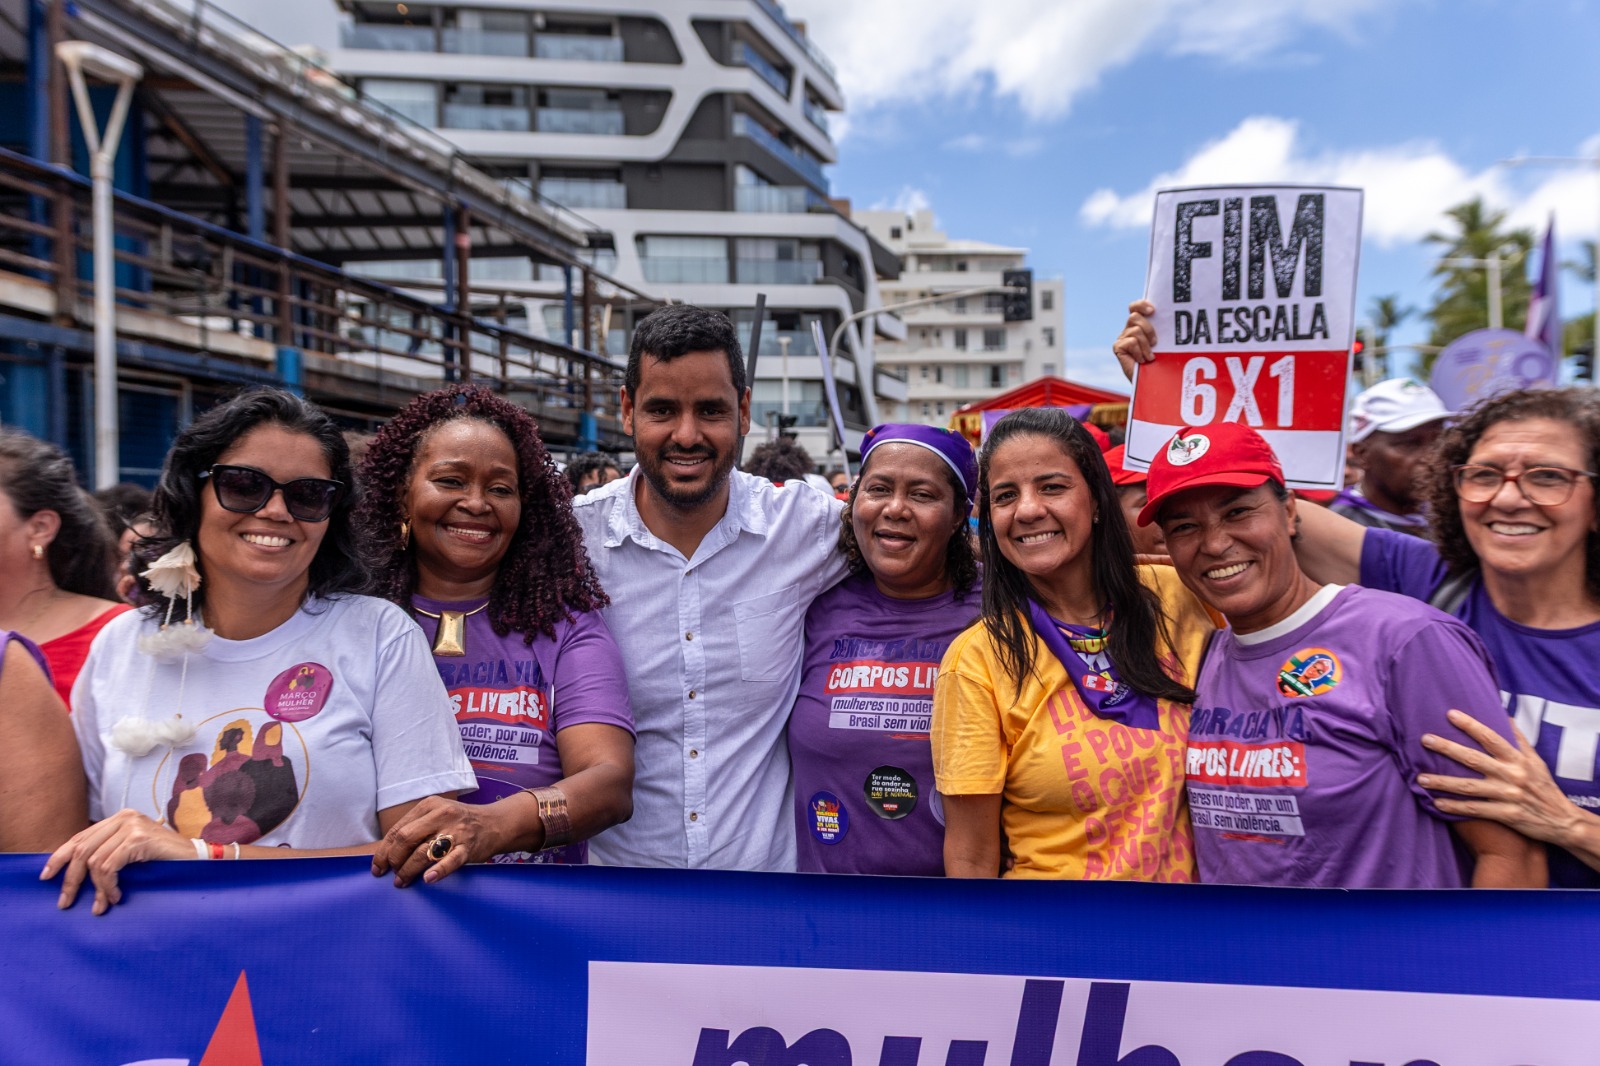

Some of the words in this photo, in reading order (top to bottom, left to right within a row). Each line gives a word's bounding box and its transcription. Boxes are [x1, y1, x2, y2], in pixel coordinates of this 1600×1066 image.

[1173, 193, 1325, 303] FIM
[1174, 309, 1212, 346] DA
[1217, 302, 1330, 344] ESCALA
[1180, 354, 1295, 427] 6X1
[829, 637, 949, 660] DEMOCRACI
[828, 665, 909, 690] CORPOS
[277, 699, 314, 707] MULHER
[280, 691, 317, 701] MARÇO
[466, 690, 544, 721] LIVRES:
[833, 697, 885, 712] mulheres
[886, 702, 900, 713] no
[459, 724, 492, 741] oder,
[495, 728, 518, 743] por
[520, 731, 539, 745] um
[849, 714, 881, 729] Brasil
[883, 717, 908, 730] sem
[910, 716, 933, 731] viol
[1062, 732, 1089, 781] É
[1185, 747, 1227, 776] RPOS
[1229, 746, 1300, 778] LIVRES:
[1072, 780, 1098, 813] O
[1098, 755, 1164, 806] QUE
[1212, 794, 1224, 807] no
[1225, 794, 1253, 812] poder,
[1255, 797, 1273, 813] por
[1275, 798, 1294, 813] um
[1214, 814, 1233, 828] sem
[1235, 815, 1284, 832] violência.
